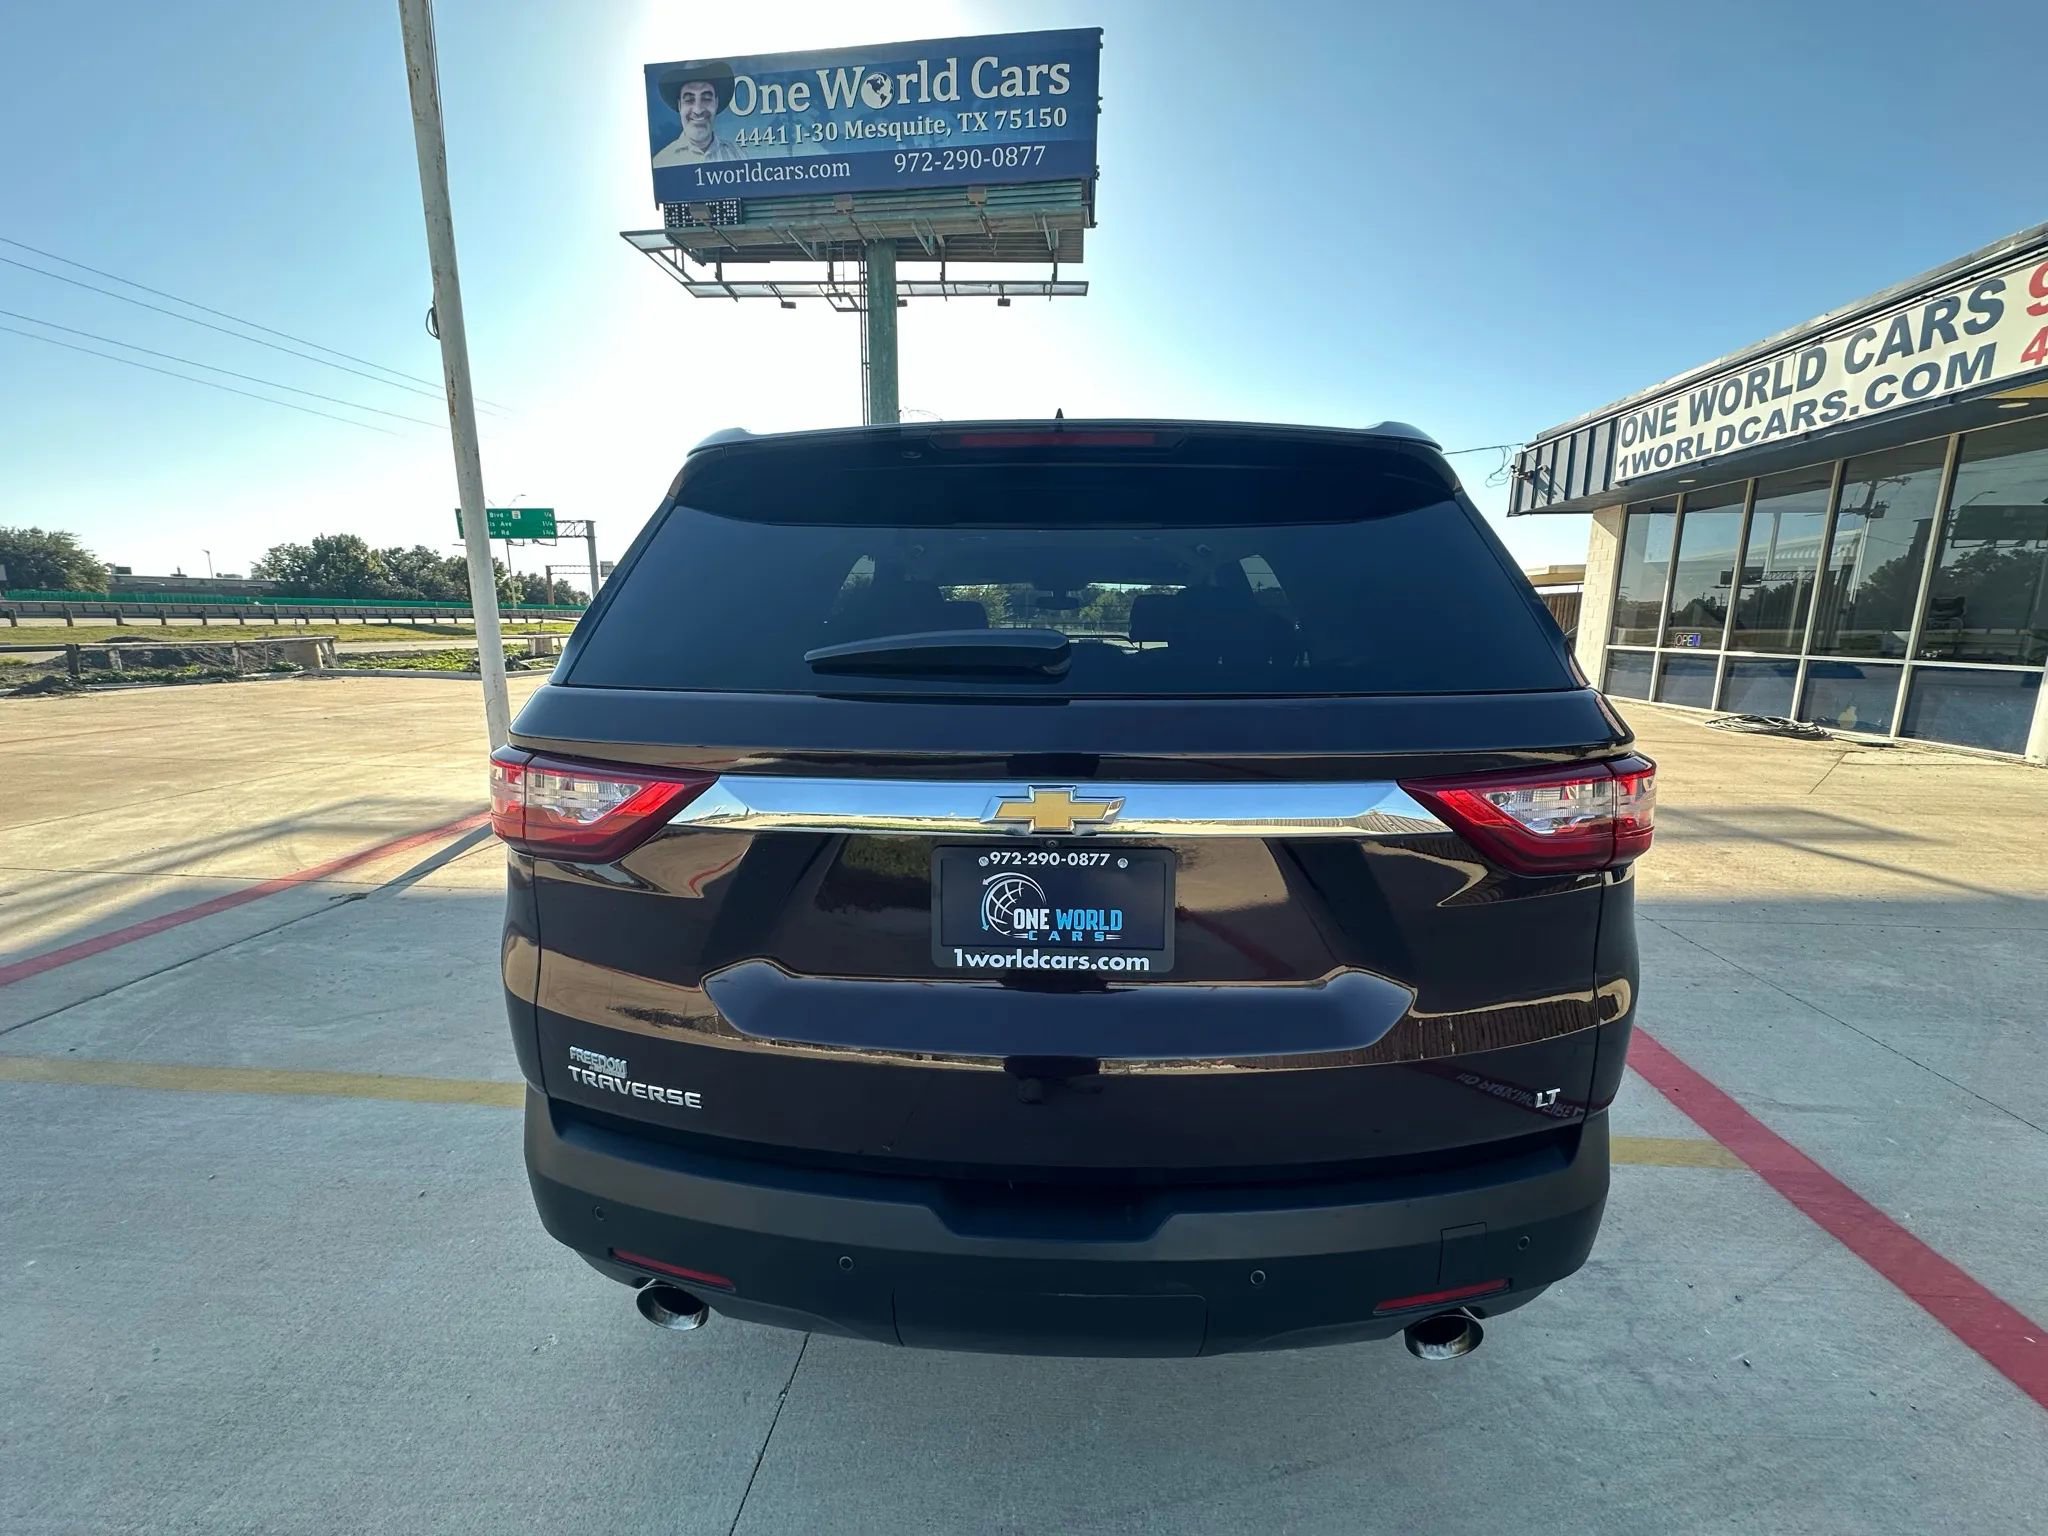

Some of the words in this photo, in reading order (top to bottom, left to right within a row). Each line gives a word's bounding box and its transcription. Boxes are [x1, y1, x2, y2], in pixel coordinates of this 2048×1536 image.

[729, 75, 811, 116] One
[816, 57, 961, 110] World
[971, 56, 1070, 100] Cars
[735, 125, 789, 148] 4441
[795, 121, 838, 144] I-30
[844, 115, 953, 142] Mesquite,
[957, 111, 989, 133] TX
[994, 107, 1067, 130] 75150
[894, 145, 1046, 173] 972-290-0877
[694, 161, 851, 187] 1worldcars.com
[1621, 399, 1679, 449] ONE
[1689, 346, 1827, 427] WORLD
[1844, 278, 2007, 375] CARS
[1618, 341, 1998, 477] 1WORLDCARS.COM
[1675, 634, 1701, 647] OPEN
[989, 851, 1111, 867] 972-290-0877
[1013, 908, 1050, 930] ONE
[1056, 908, 1123, 931] WORLD
[1028, 931, 1105, 942] CARS
[954, 948, 1150, 971] 1worldcars.com
[569, 1045, 628, 1073] FREEDOM
[568, 1065, 702, 1109] TRAVERSE
[1536, 1087, 1561, 1108] LT
